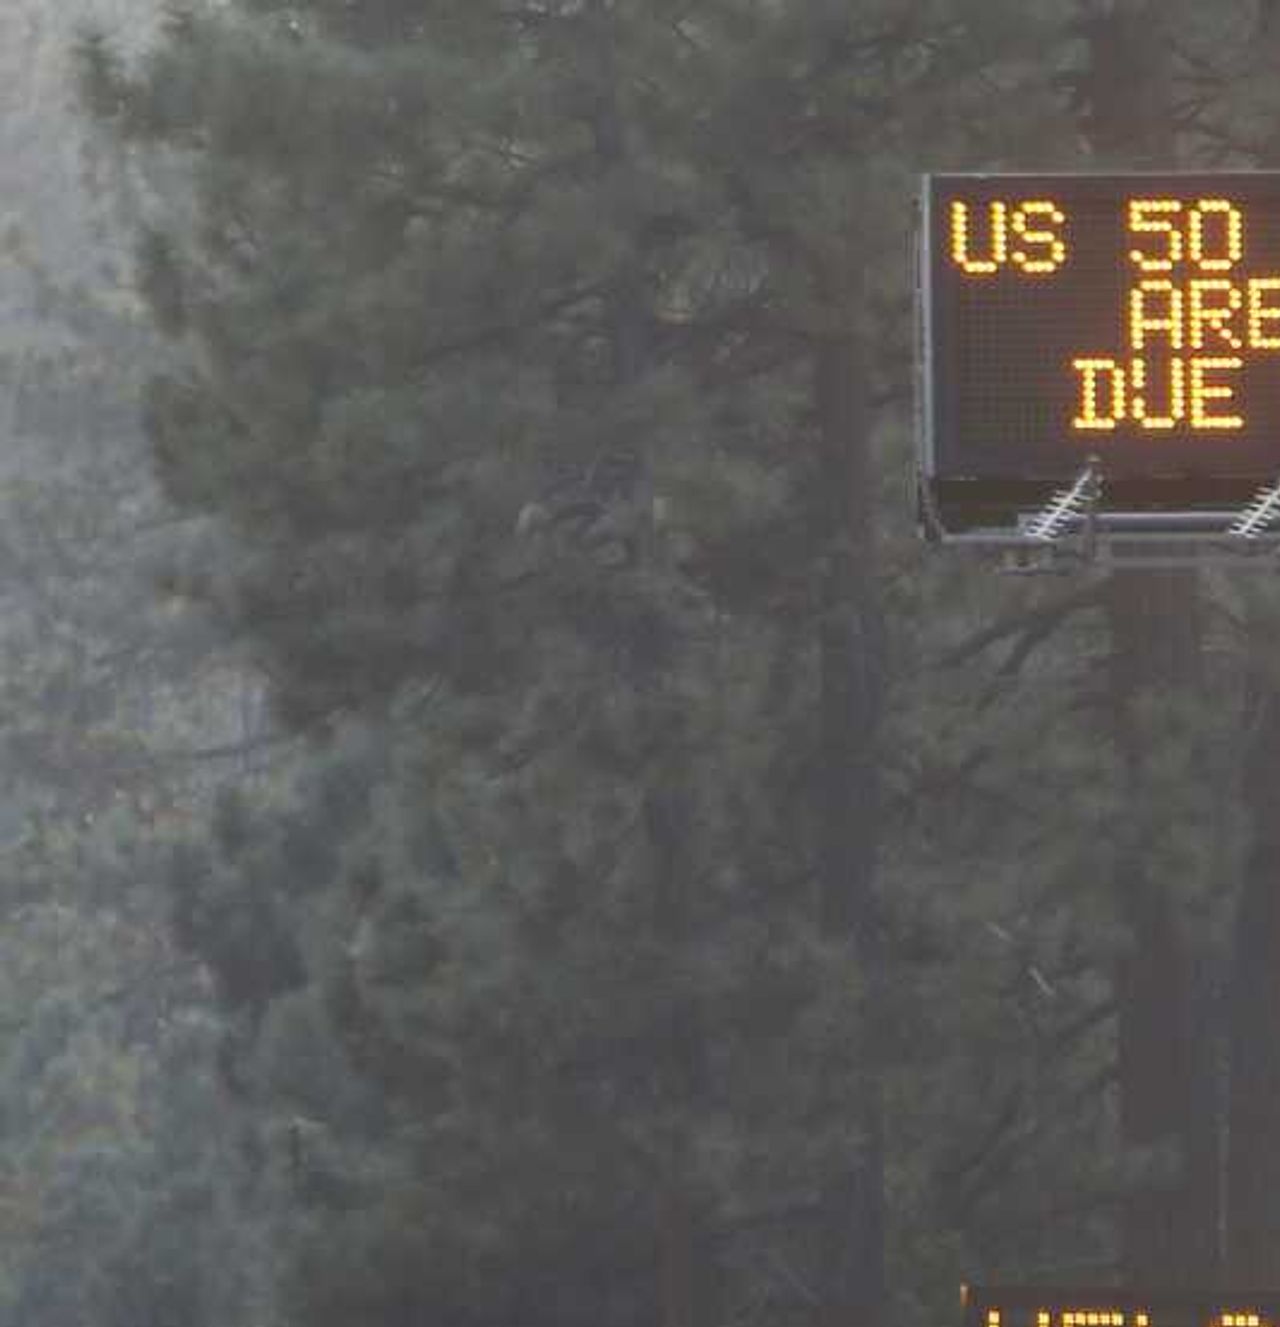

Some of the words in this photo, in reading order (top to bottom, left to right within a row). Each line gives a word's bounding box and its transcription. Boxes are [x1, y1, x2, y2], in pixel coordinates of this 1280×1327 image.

[951, 201, 1066, 273] US
[1128, 199, 1242, 273] 50
[1071, 353, 1244, 430] DUE
